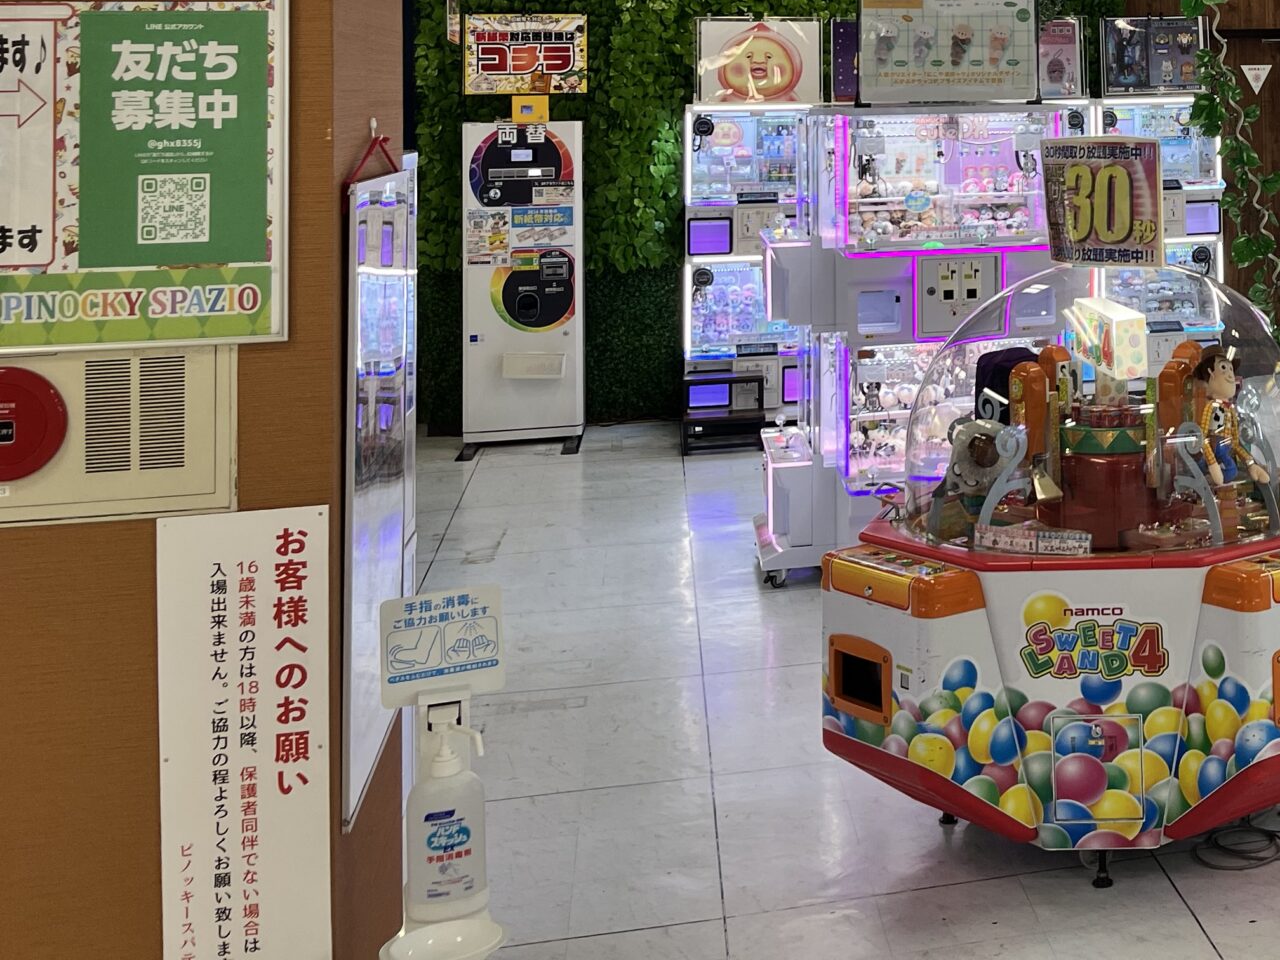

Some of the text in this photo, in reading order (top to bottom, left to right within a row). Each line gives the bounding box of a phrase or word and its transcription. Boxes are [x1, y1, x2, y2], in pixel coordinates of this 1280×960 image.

[111, 38, 239, 82] 友だち
[477, 43, 575, 75] コチラ
[111, 89, 238, 131] 募集中
[497, 124, 547, 144] 両替
[163, 205, 185, 213] LINE
[3, 285, 259, 322] PINOCKY SPAZIO
[393, 606, 490, 630] ご協力お願いします
[404, 594, 480, 616] 手指の消毒に
[1063, 607, 1124, 617] namco
[1022, 624, 1166, 678] LAND 4
[1028, 621, 1138, 656] SWEET
[273, 526, 310, 796] お客様へのお願い
[209, 561, 232, 960] 入場出来ません。ご協力の程よろしくお願い致しま
